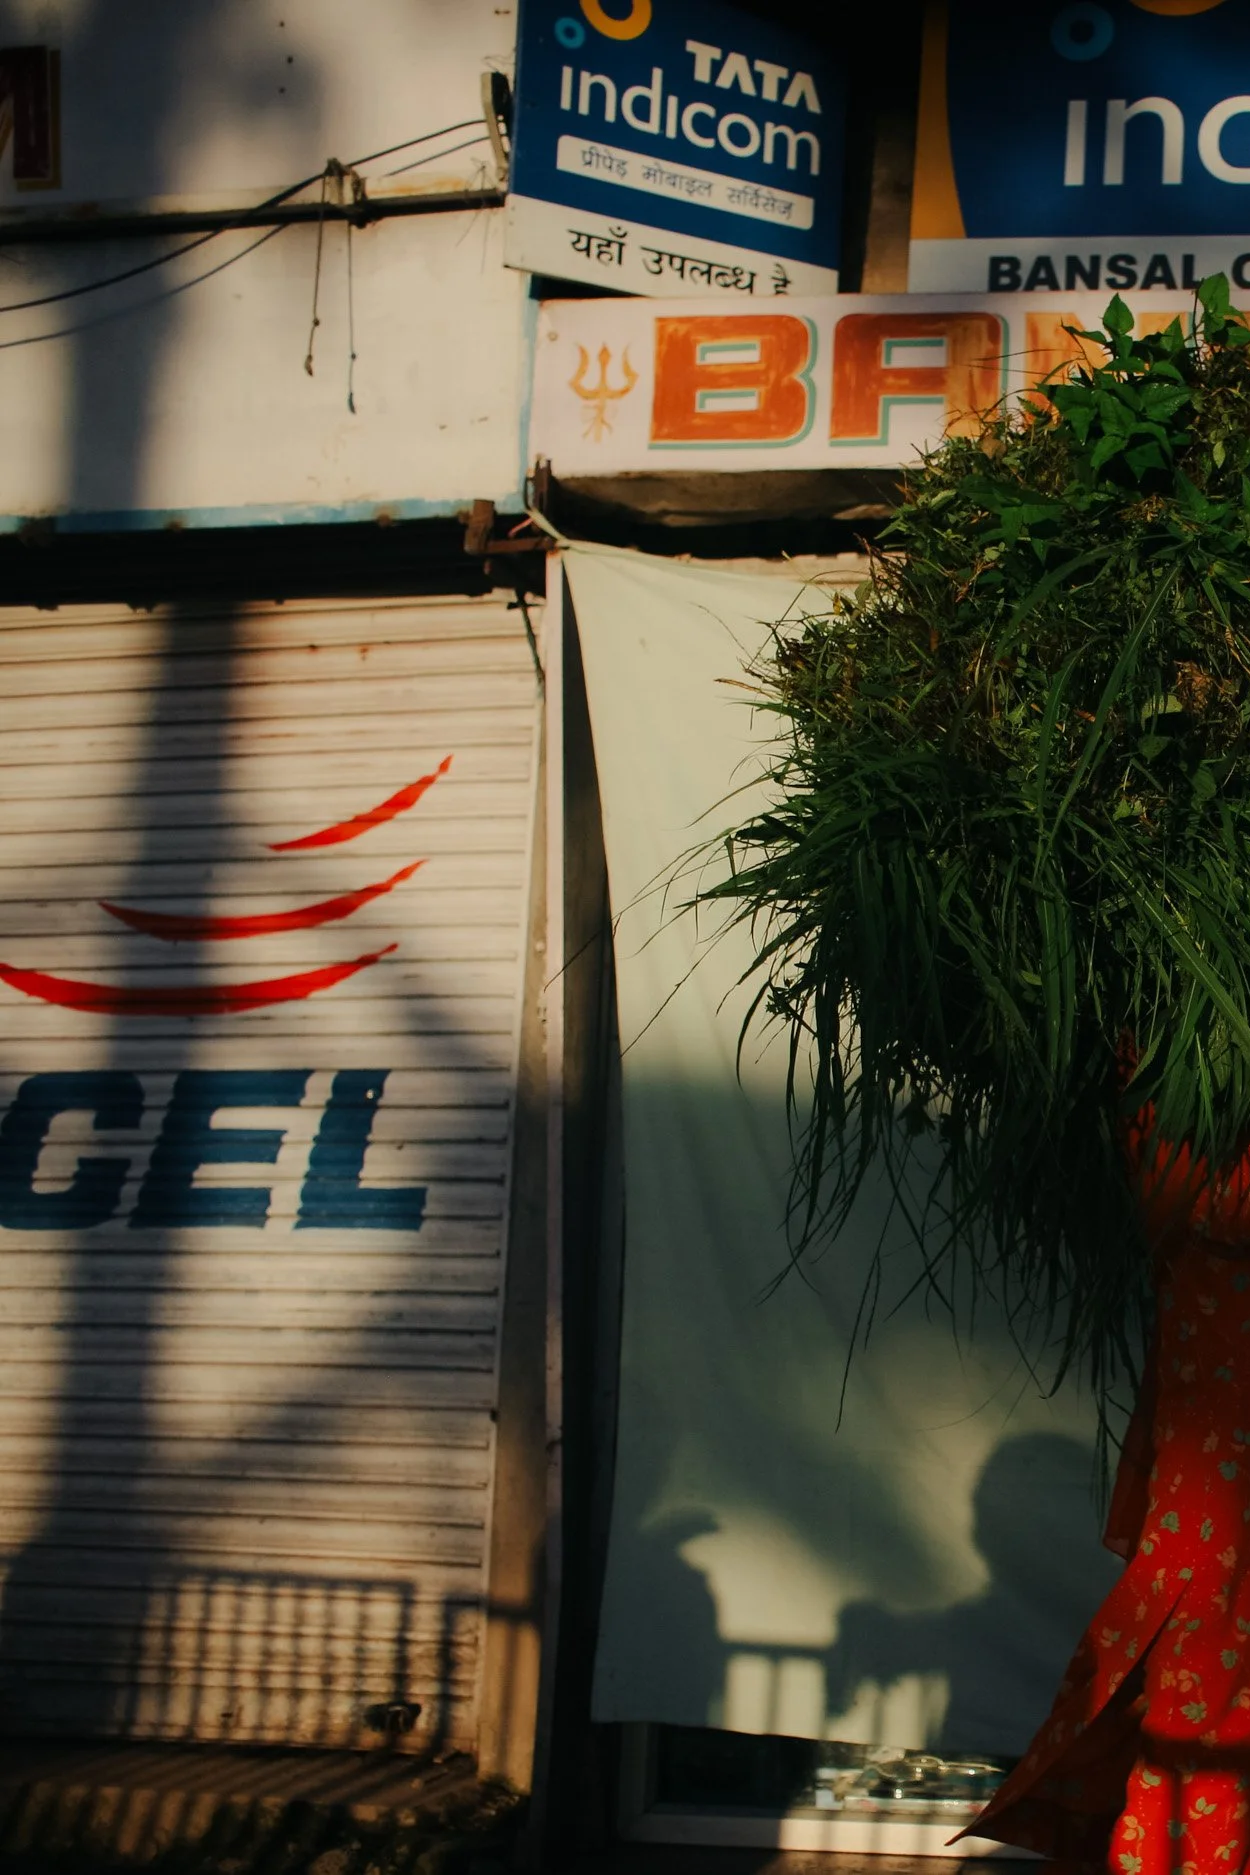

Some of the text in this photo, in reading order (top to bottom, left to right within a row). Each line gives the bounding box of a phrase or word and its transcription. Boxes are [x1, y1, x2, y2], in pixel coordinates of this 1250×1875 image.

[685, 39, 822, 115] TATA
[560, 65, 821, 176] indicom
[641, 160, 715, 198] मोबाइल
[567, 225, 628, 267] यहाँ
[639, 245, 757, 295] उपलब्ध
[988, 253, 1204, 292] BANSAL
